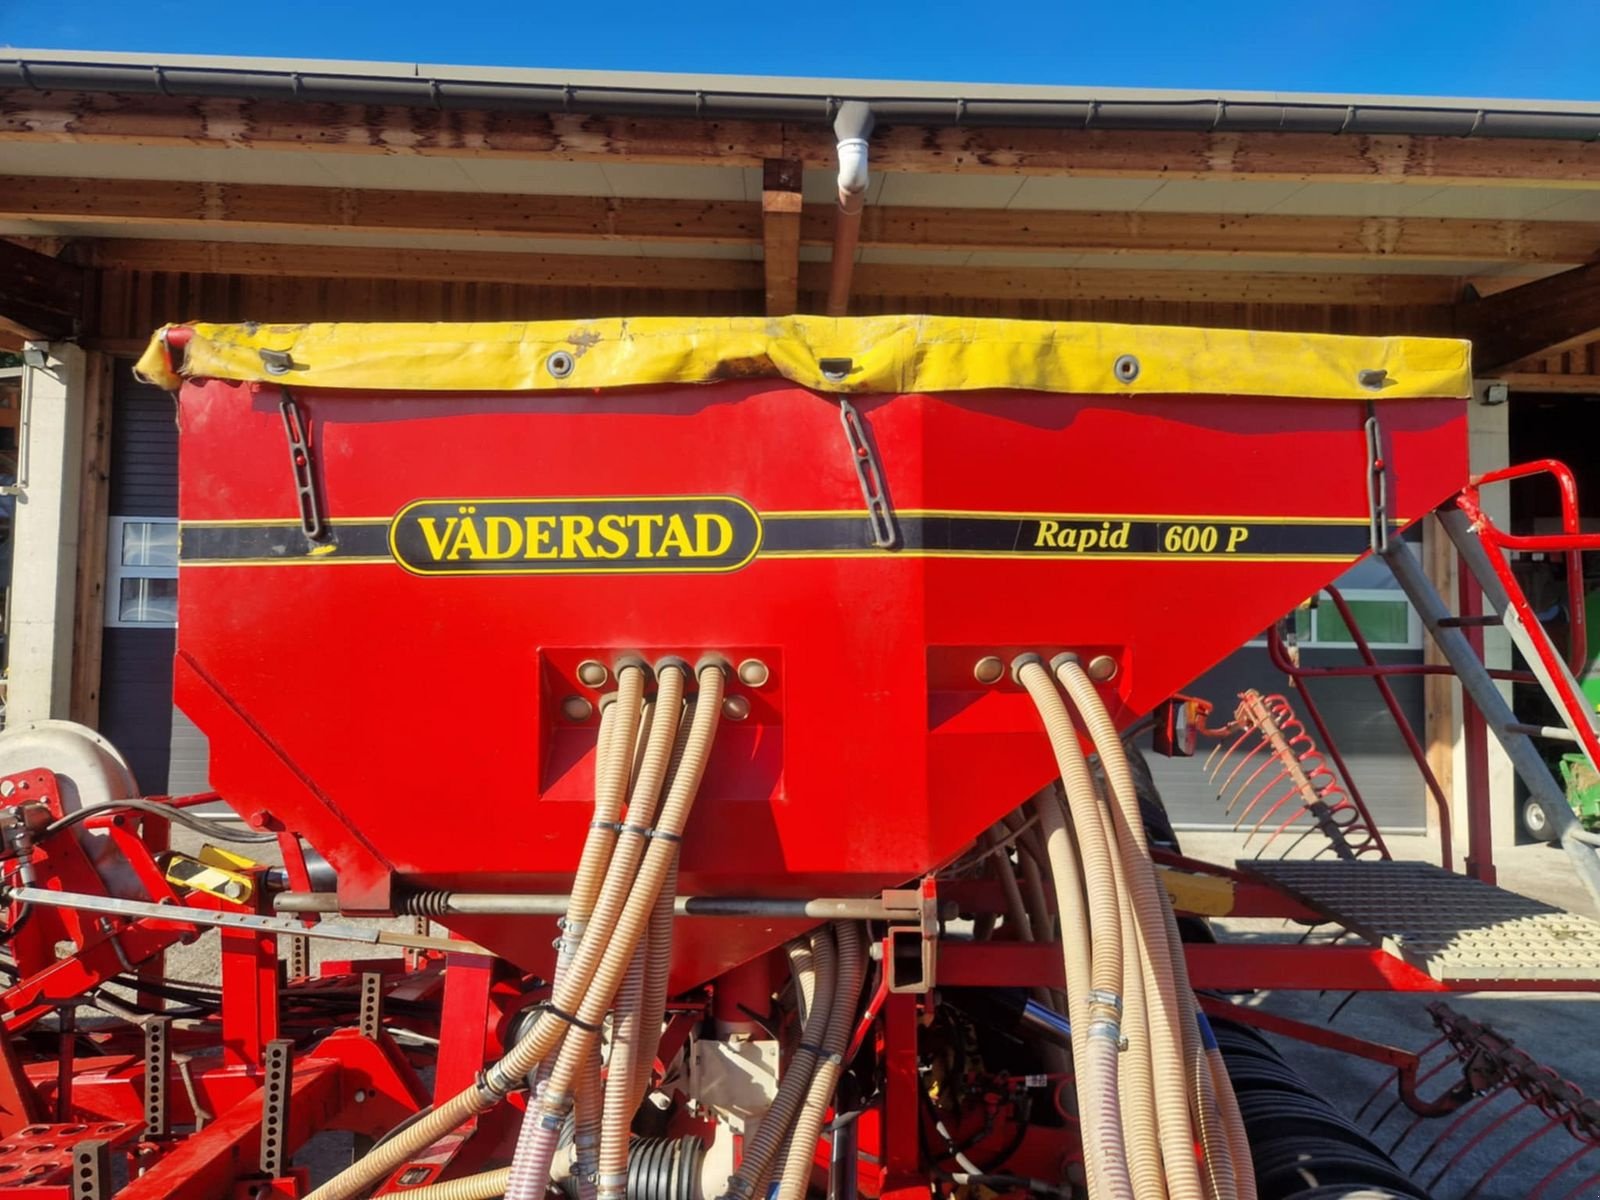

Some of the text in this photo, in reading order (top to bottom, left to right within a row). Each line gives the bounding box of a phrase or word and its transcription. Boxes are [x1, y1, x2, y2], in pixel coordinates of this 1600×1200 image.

[417, 506, 734, 560] VÄDERSTAD
[1034, 520, 1249, 553] Rapid 600 P
